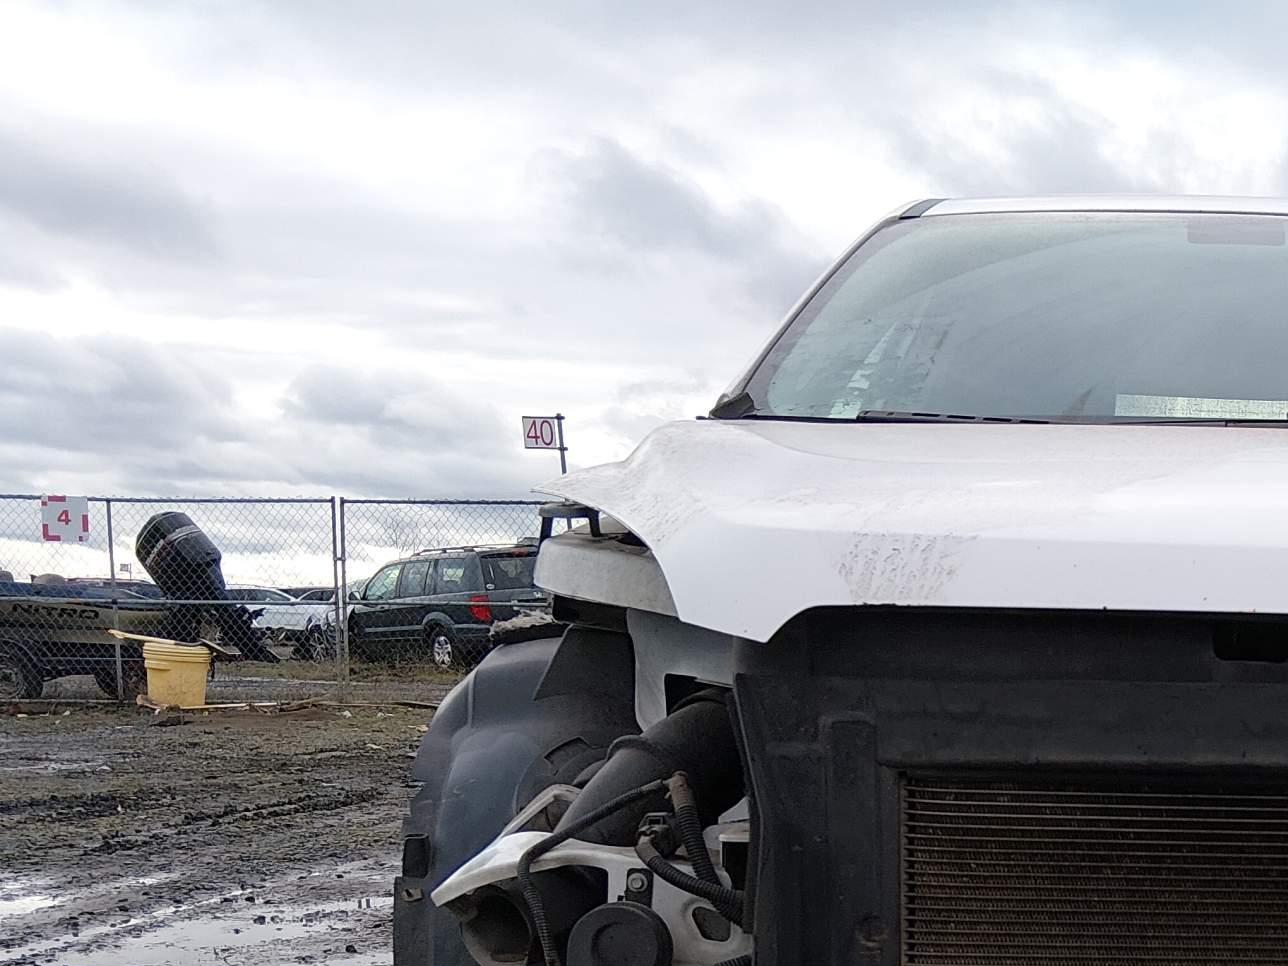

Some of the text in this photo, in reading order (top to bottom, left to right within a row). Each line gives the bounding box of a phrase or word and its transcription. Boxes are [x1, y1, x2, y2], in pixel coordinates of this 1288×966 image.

[527, 420, 553, 446] 40
[57, 510, 71, 525] 4
[11, 603, 99, 620] NITRO
